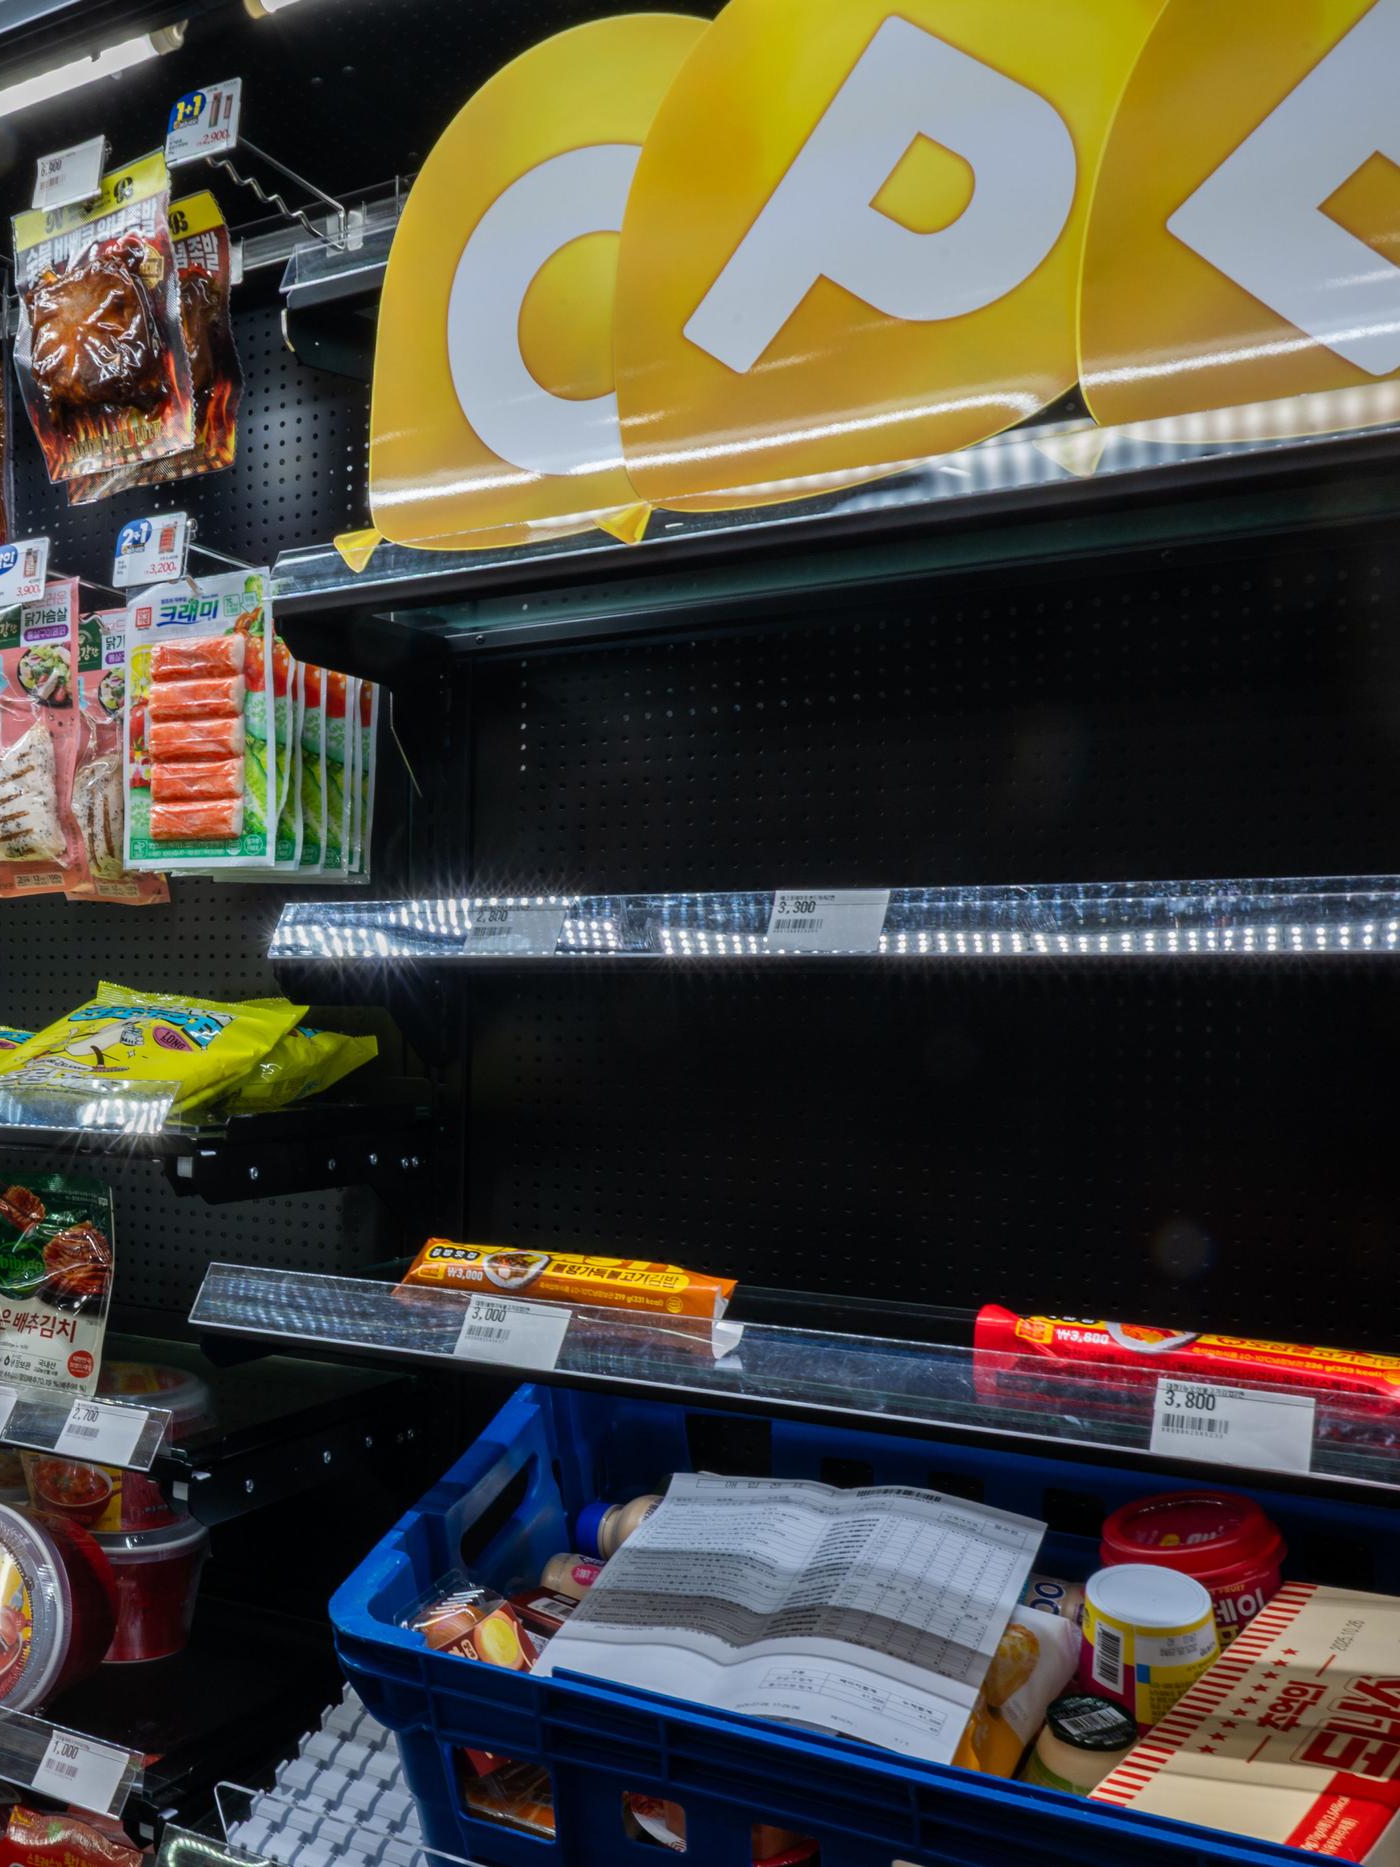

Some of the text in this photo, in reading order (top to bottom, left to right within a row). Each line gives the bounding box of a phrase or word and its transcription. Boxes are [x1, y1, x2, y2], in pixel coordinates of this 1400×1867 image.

[176, 94, 202, 120] 1+1
[123, 523, 148, 546] 2+1
[151, 562, 174, 573] 3,200
[24, 609, 67, 627] 닭가슴살
[160, 599, 219, 622] 크래미
[778, 901, 815, 914] 3,300
[159, 1031, 187, 1051] LONG
[447, 1267, 483, 1281] ₩3,000
[472, 1307, 506, 1323] 3,000
[13, 1311, 77, 1343] 배추김치
[1164, 1389, 1216, 1412] 3,800
[72, 1408, 98, 1423] 2,700
[1256, 1679, 1328, 1732] 추억의
[53, 1740, 78, 1759] 1,000
